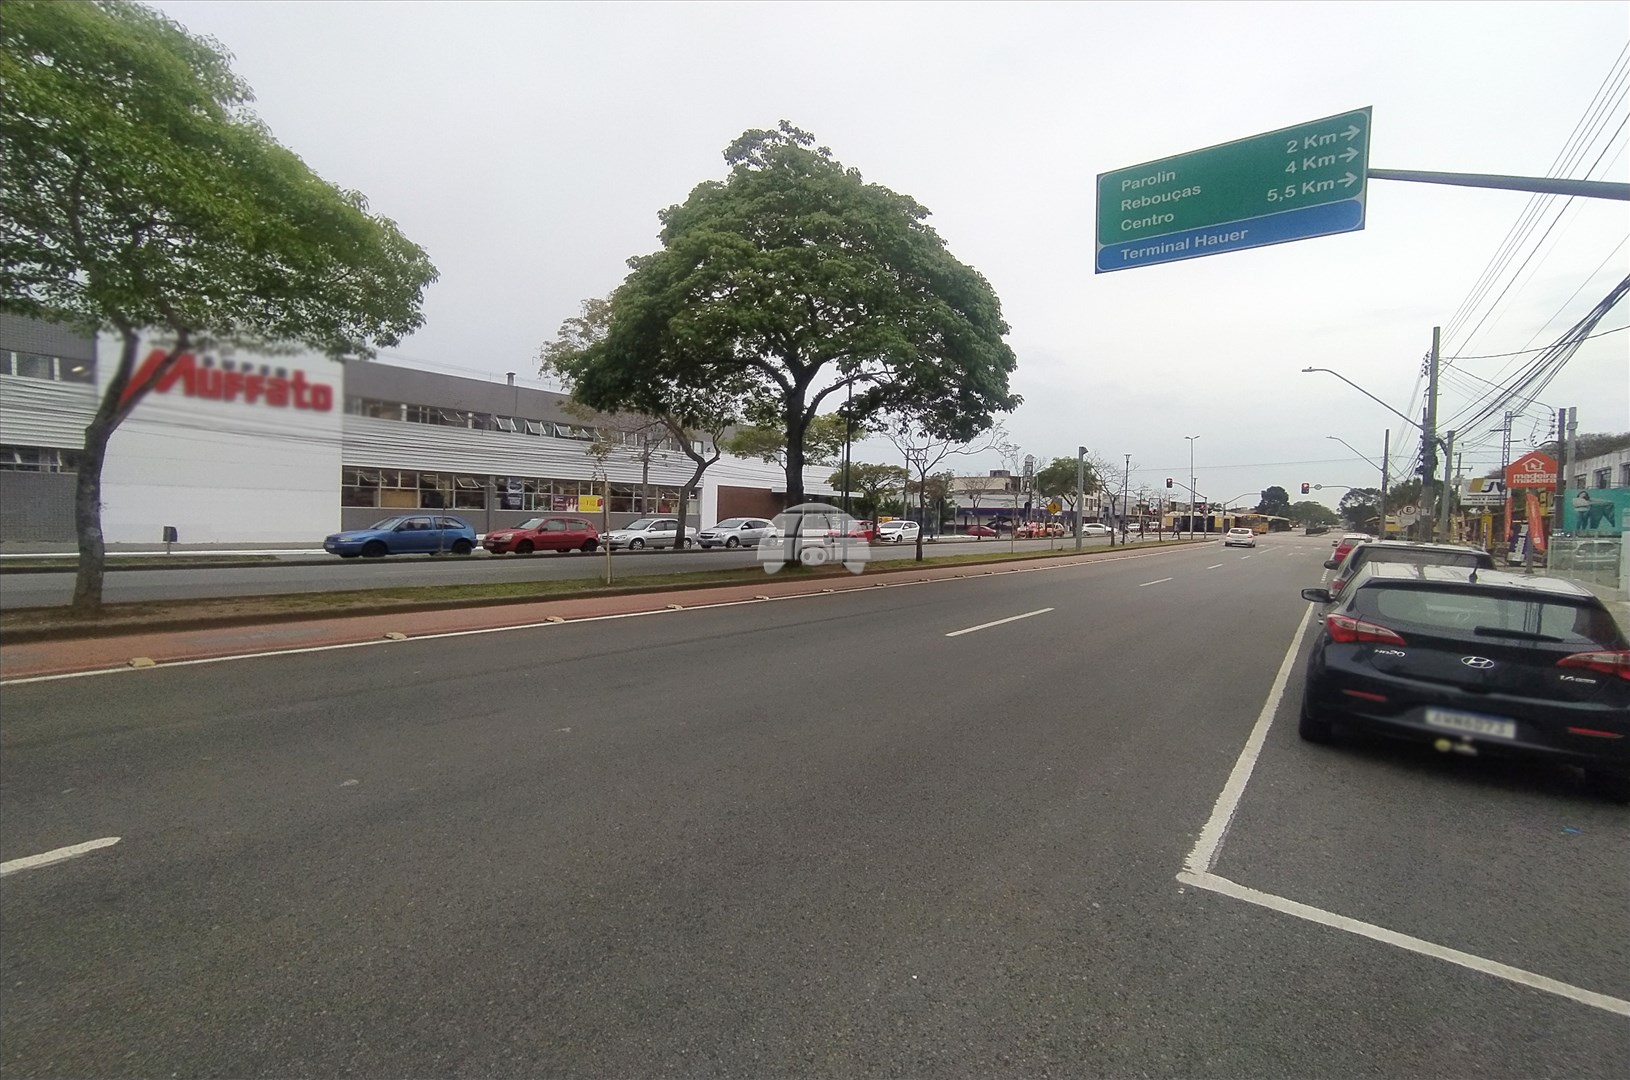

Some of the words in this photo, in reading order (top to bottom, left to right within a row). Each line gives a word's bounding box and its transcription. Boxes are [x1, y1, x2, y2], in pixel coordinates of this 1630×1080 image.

[1287, 139, 1298, 154] 2
[1304, 133, 1337, 150] Km
[1285, 161, 1297, 175] 4
[1303, 154, 1336, 171] Km
[1121, 170, 1176, 191] Parolin
[1121, 185, 1202, 211] Rebouças
[1267, 184, 1296, 203] 5,5
[1302, 180, 1335, 196] Km
[1121, 213, 1175, 232] Centro
[1121, 238, 1190, 261] Terminal
[1195, 229, 1249, 248] Hauer
